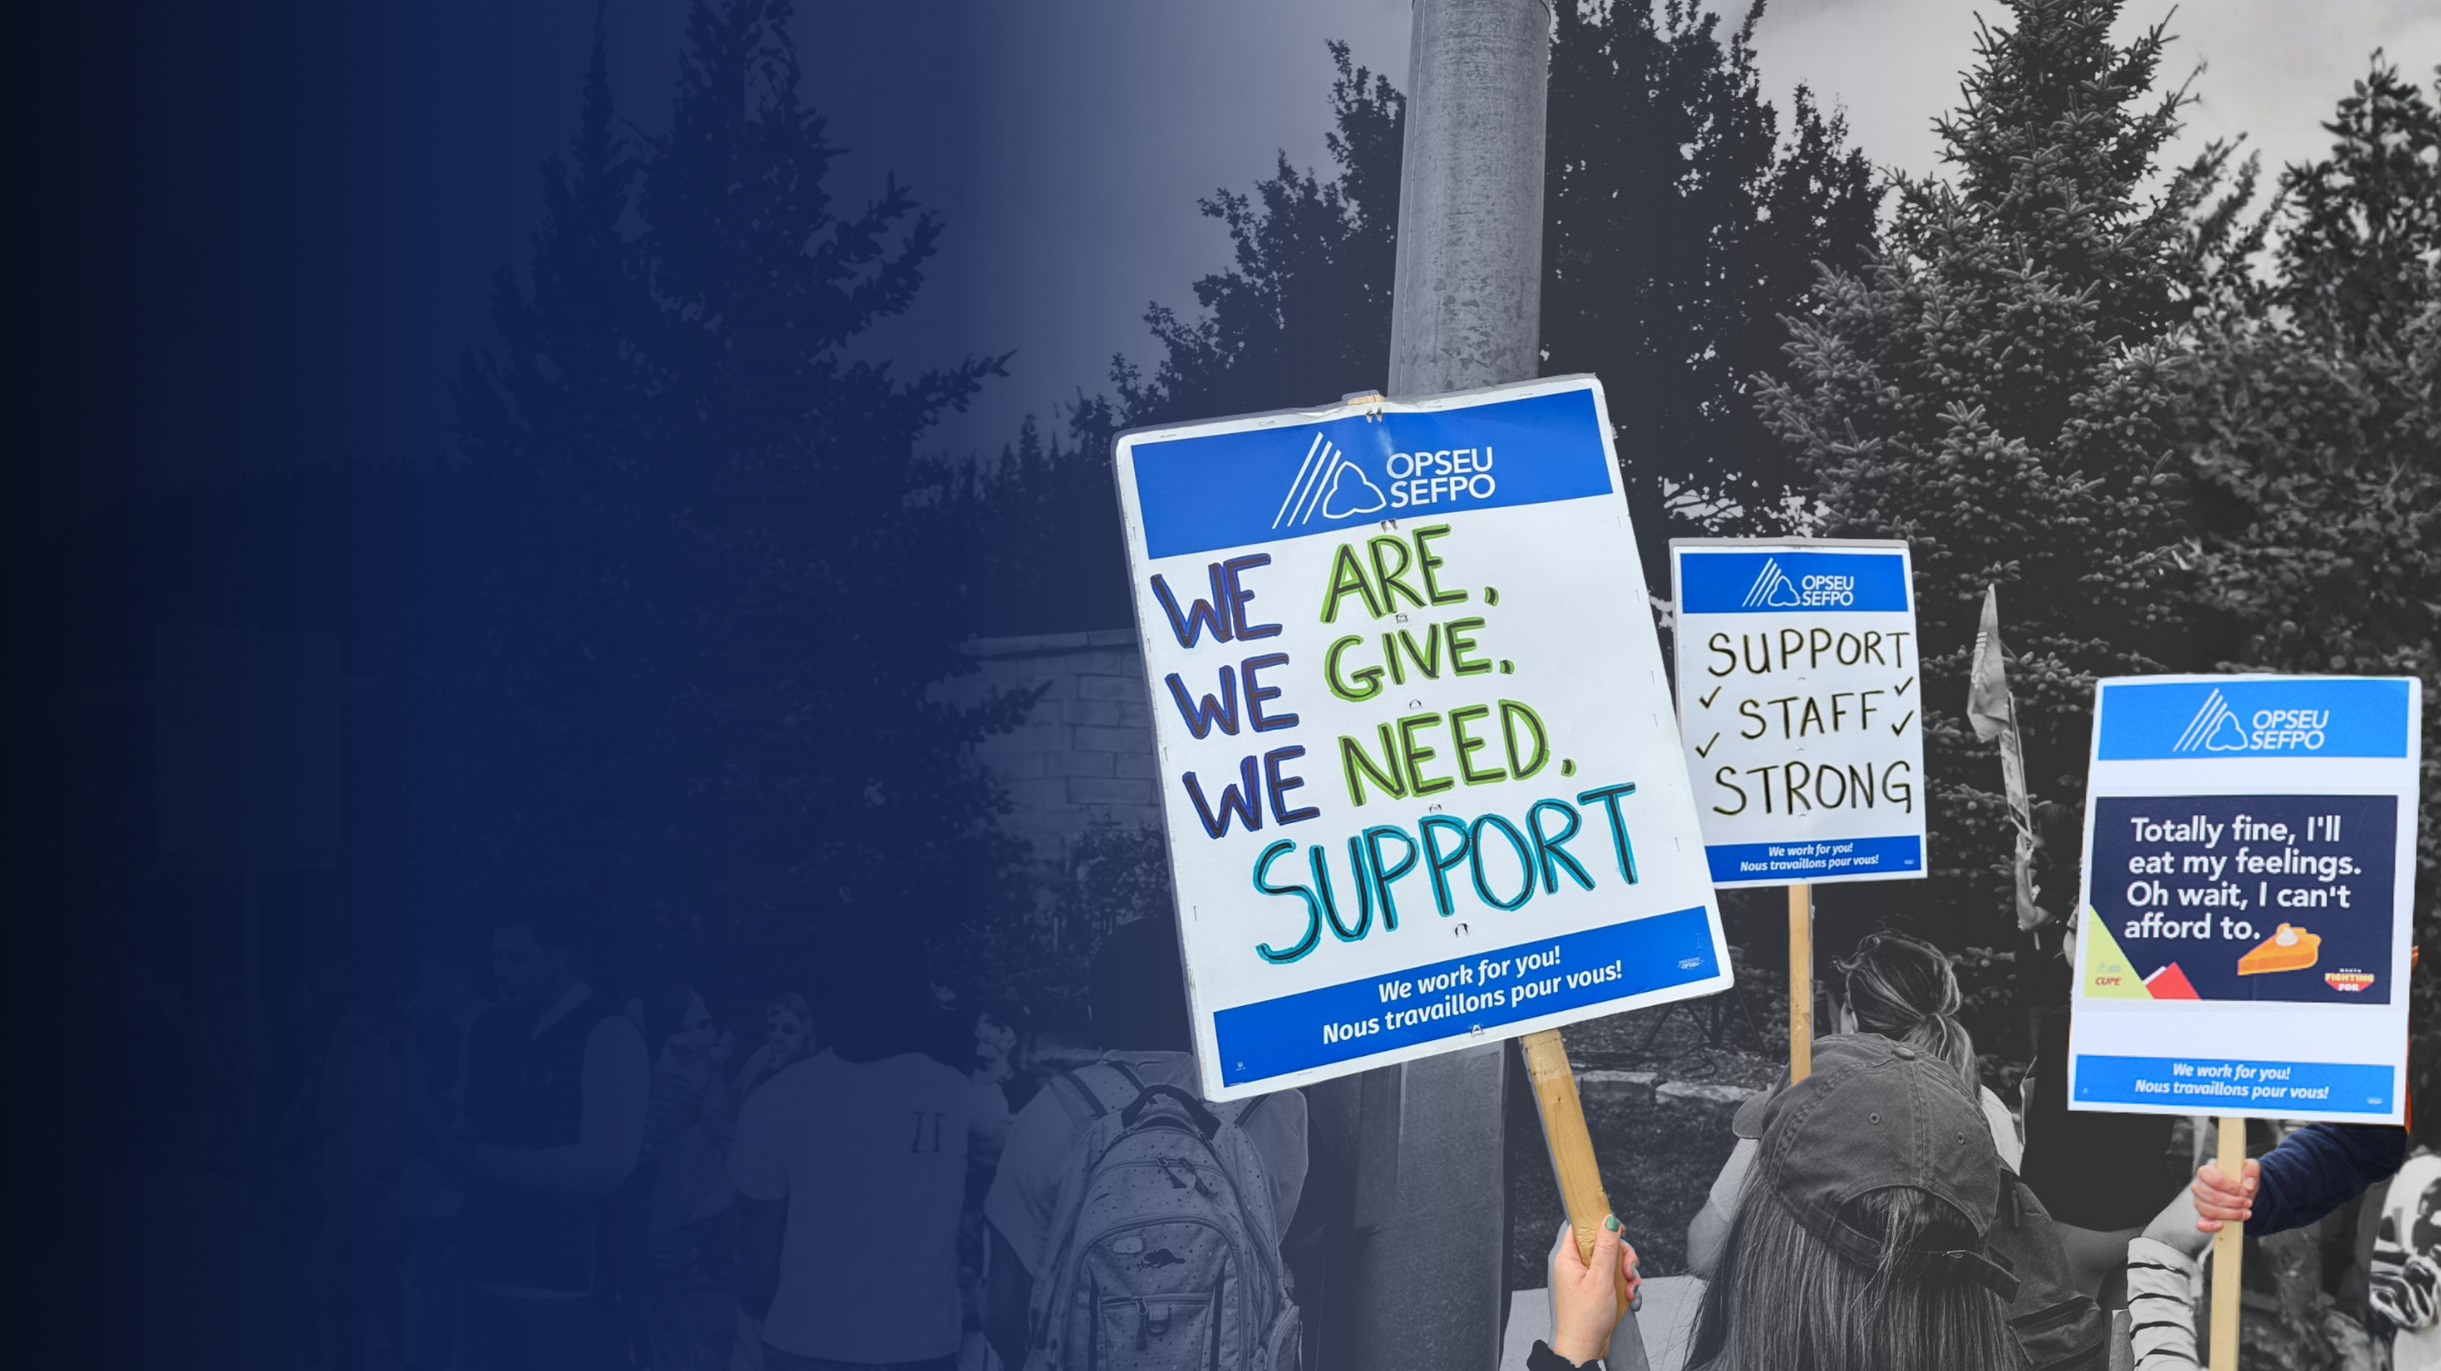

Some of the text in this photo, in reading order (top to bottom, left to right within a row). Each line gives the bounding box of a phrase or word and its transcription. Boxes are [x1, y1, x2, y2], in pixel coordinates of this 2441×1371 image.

[1386, 446, 1494, 480] OPSEU
[1390, 474, 1496, 508] SEFPO
[1802, 575, 1854, 591] OPSEU
[1151, 553, 1282, 648] WE
[1802, 592, 1854, 607] SEFPO
[1707, 627, 1911, 677] SUPPORT
[1165, 653, 1300, 739] WE
[1738, 690, 1885, 740] STAFF
[2251, 710, 2330, 729] OPSEU
[2248, 730, 2326, 750] SEFPO
[1182, 744, 1320, 839] WE
[1712, 760, 1912, 816] STRONG
[2130, 814, 2341, 849] Totally fine, I'll
[1740, 854, 1879, 872] Nous travaillons pour vous!
[1768, 842, 1854, 857] We work for you!
[2128, 847, 2362, 882] eat my feelings.
[1253, 782, 1638, 965] SUPPORT
[2127, 880, 2351, 911] Oh wait, I can't
[2124, 911, 2261, 940] afford to.
[1378, 945, 1561, 1003] We work for you!
[2095, 976, 2122, 986] CUPE
[2325, 973, 2375, 982] FIGHTING
[2338, 983, 2360, 991] FOR
[1323, 960, 1623, 1044] Nous travaillons pour vous!
[2173, 1063, 2291, 1083] We work for you!
[2135, 1079, 2330, 1101] Nous travaillons pour vous!
